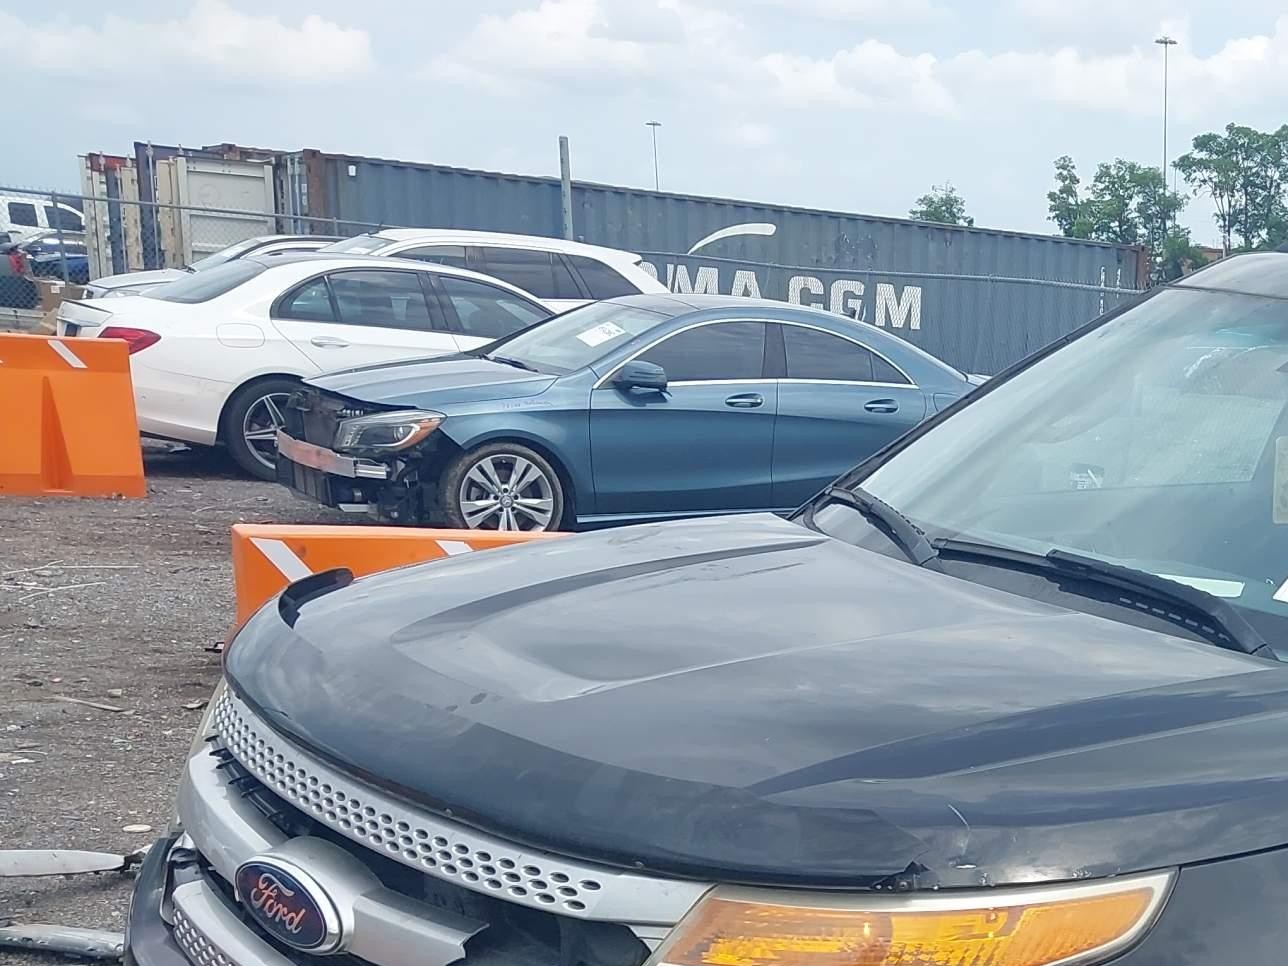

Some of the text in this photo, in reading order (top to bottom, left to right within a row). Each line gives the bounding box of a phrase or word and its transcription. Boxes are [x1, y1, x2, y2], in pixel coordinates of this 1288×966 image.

[639, 262, 922, 330] MA CGM
[250, 872, 307, 934] Ford
